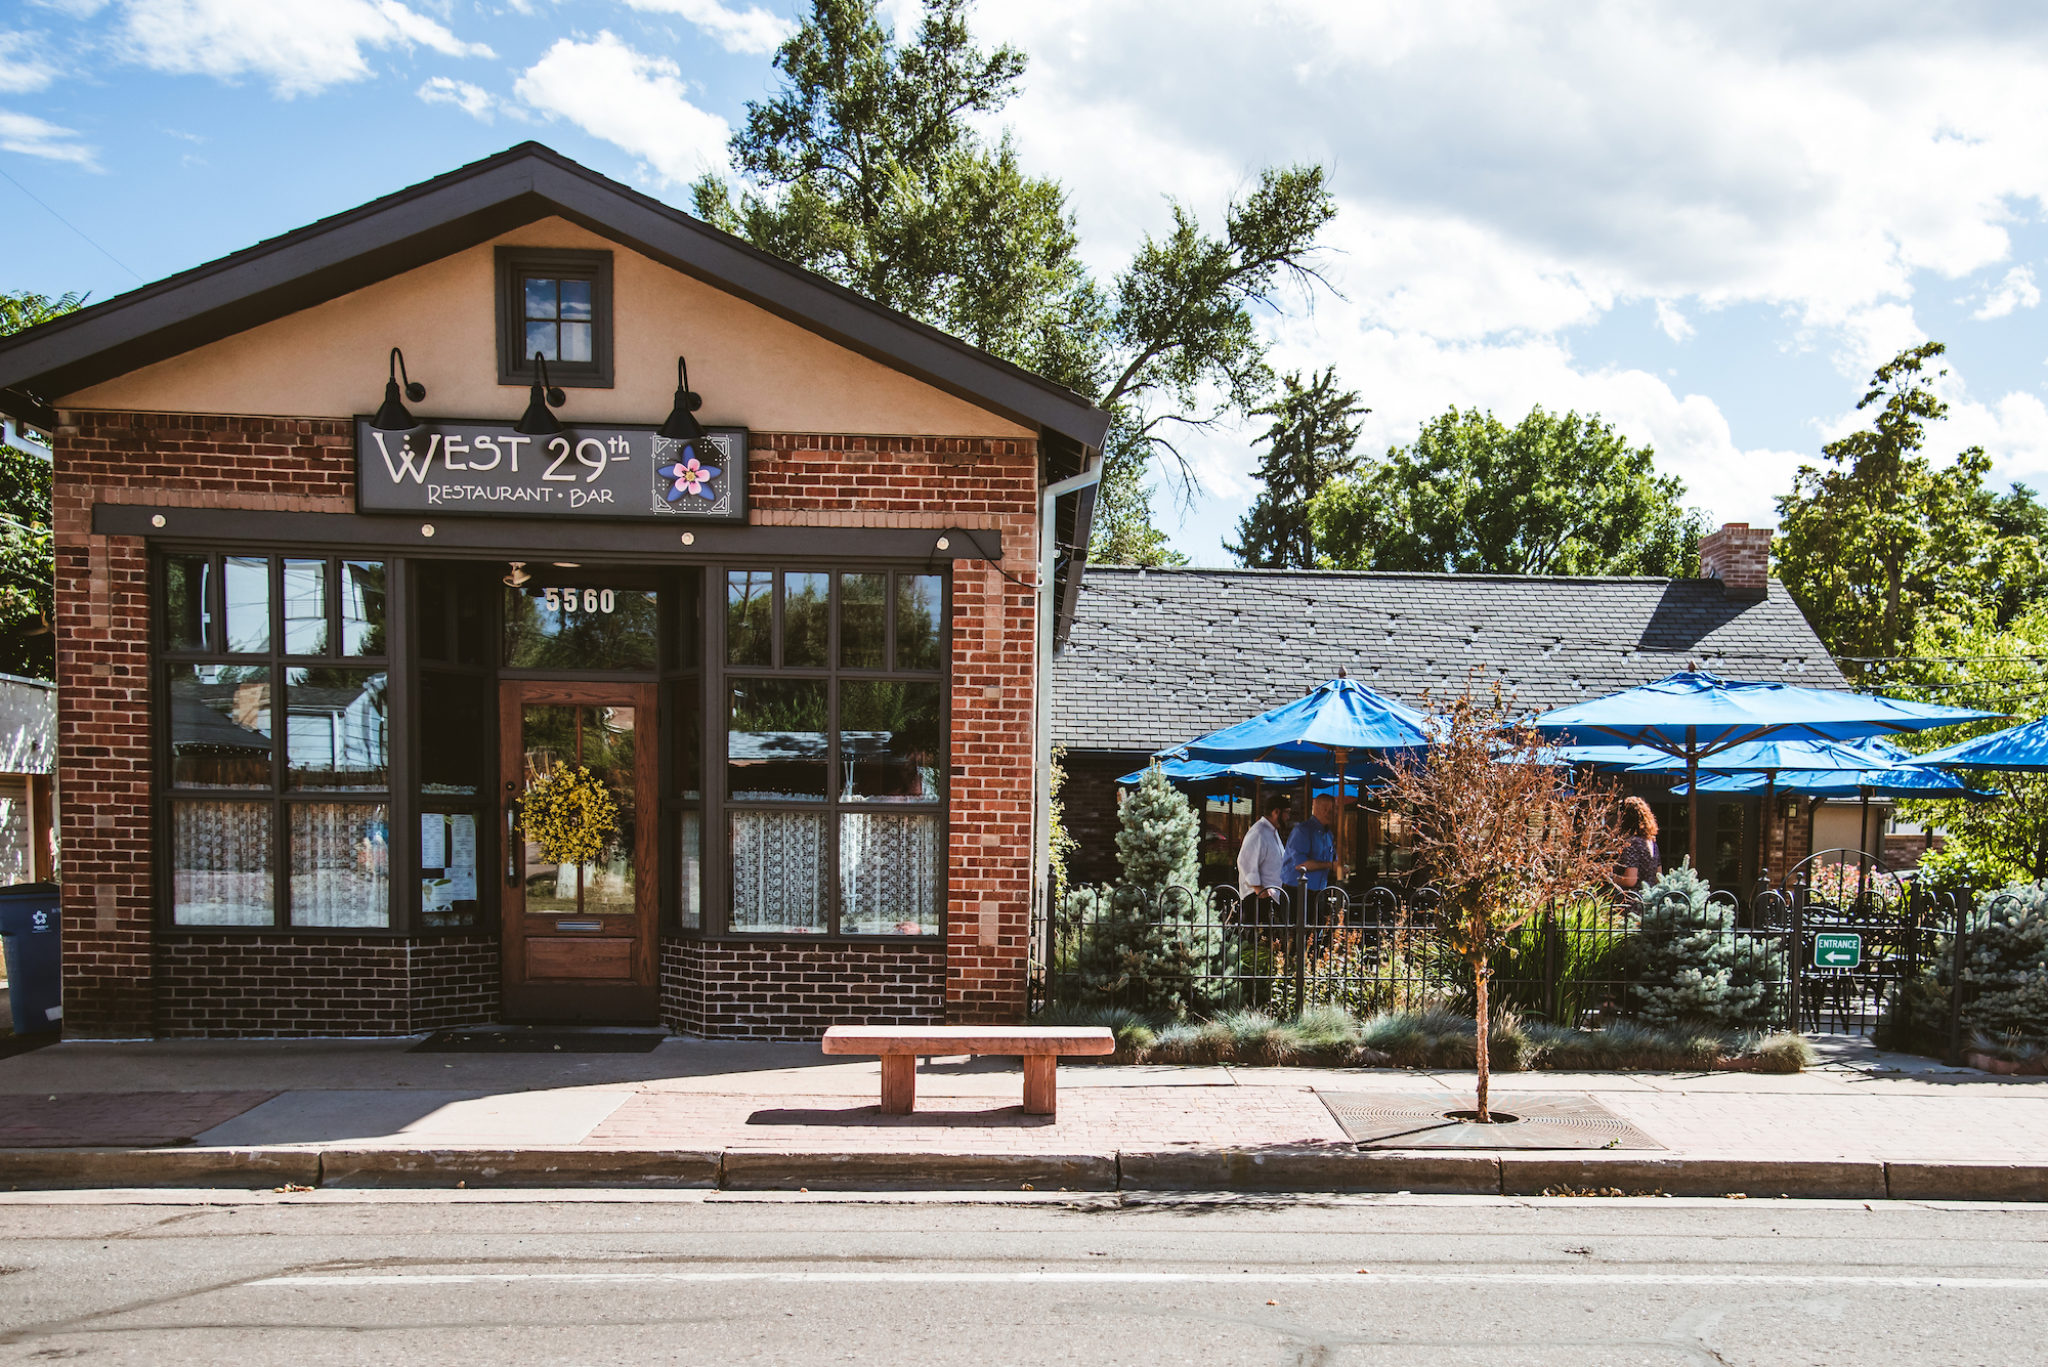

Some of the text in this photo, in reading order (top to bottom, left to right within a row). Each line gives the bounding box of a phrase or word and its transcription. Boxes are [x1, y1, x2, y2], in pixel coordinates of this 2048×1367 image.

[372, 431, 631, 485] WEST 29th
[427, 484, 615, 508] RESTAURANT BAR
[546, 587, 615, 614] 5560
[1818, 939, 1858, 949] ENTRANCE
